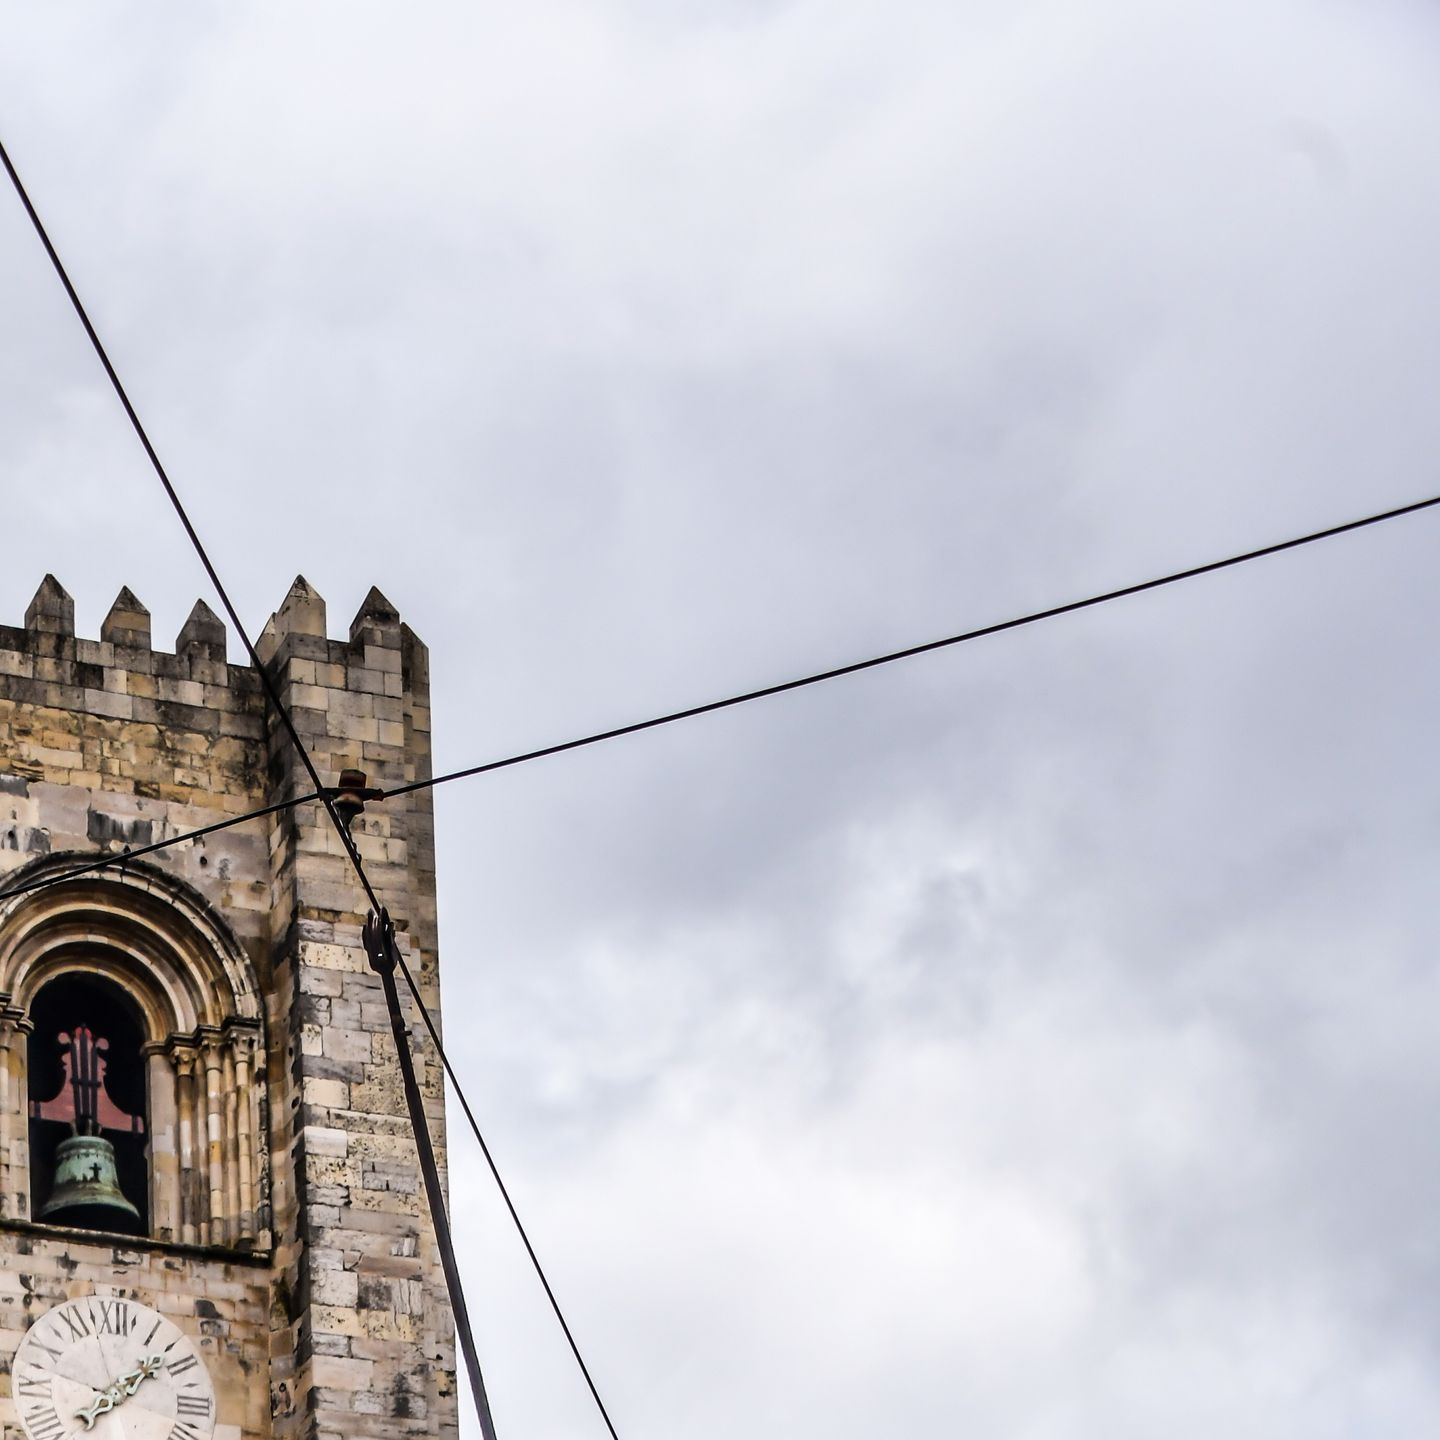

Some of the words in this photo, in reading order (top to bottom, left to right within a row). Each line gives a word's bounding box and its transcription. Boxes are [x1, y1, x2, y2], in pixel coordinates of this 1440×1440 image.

[58, 1304, 90, 1343] XI
[98, 1300, 128, 1337] XII
[143, 1319, 162, 1347] I
[27, 1331, 64, 1365] X
[166, 1353, 199, 1377] II
[18, 1374, 53, 1399] IX
[176, 1394, 210, 1418] III
